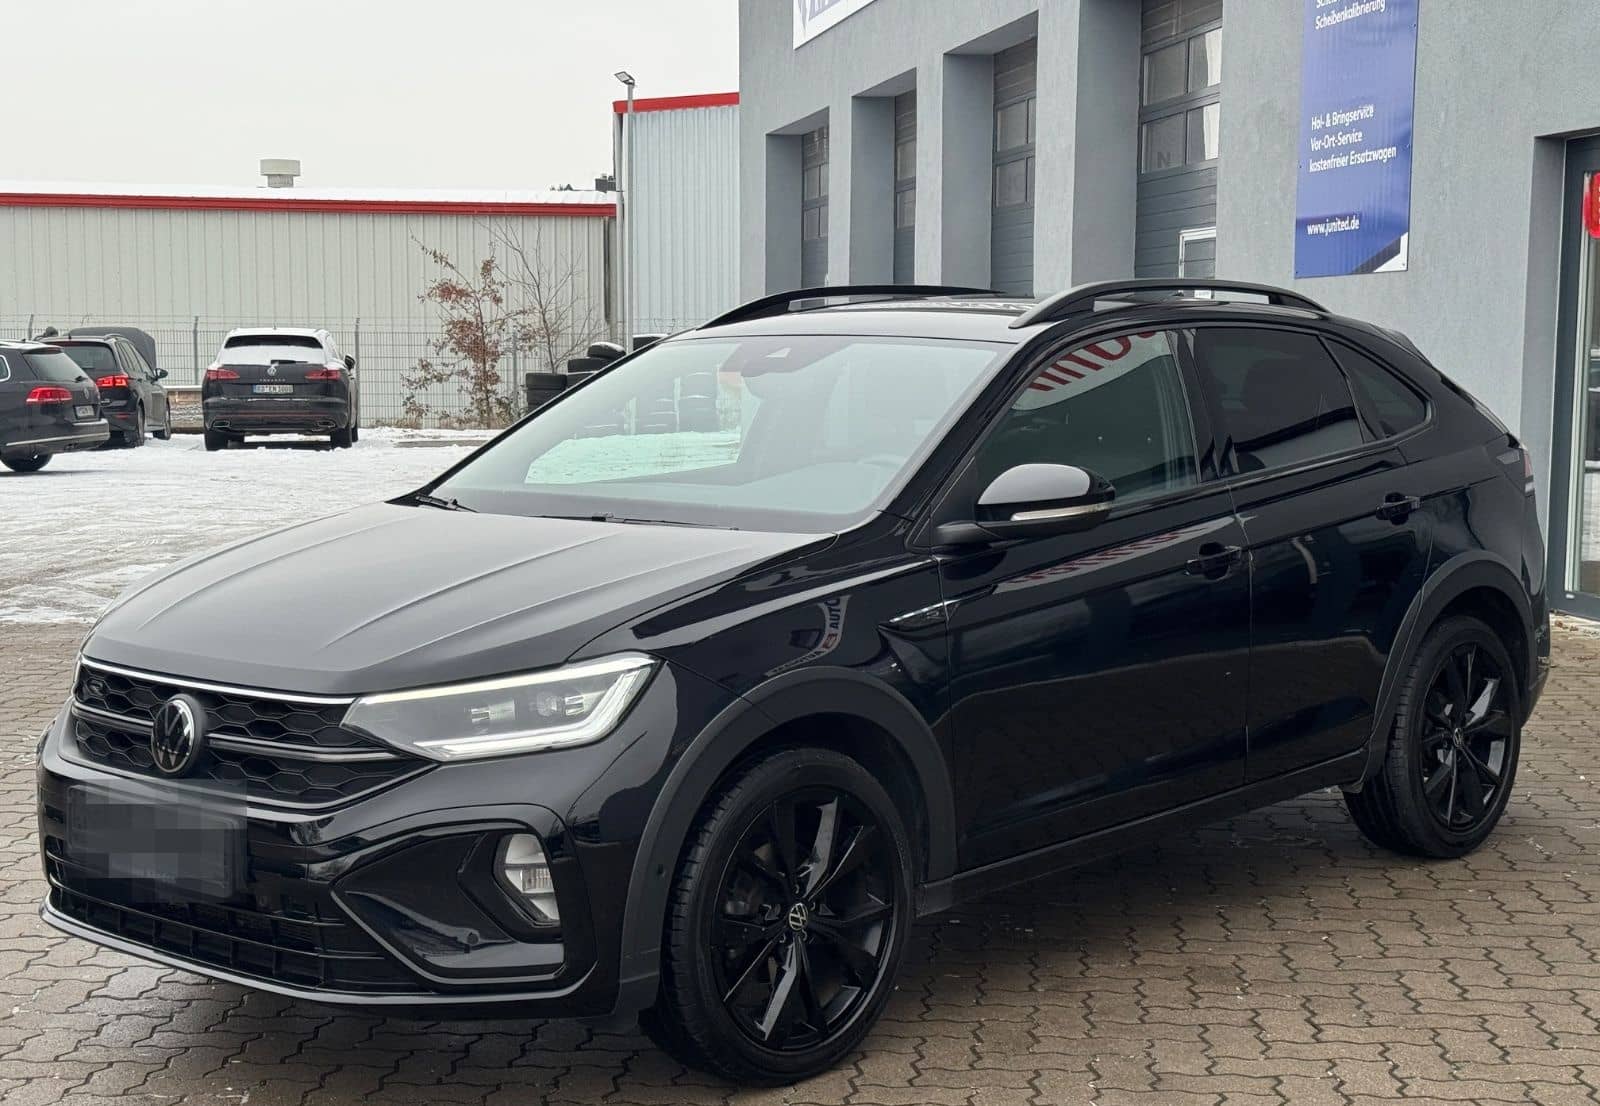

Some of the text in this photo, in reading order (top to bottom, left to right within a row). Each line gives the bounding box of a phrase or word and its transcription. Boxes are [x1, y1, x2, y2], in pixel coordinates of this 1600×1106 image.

[1315, 0, 1386, 30] Scheibenkalibrierung
[1311, 104, 1374, 131] Hol- & Bringservice
[1310, 128, 1363, 152] Vor-Ort-Service
[1309, 146, 1397, 173] kostenfreier Ersatzwagen
[1307, 214, 1360, 237] www.junited.de
